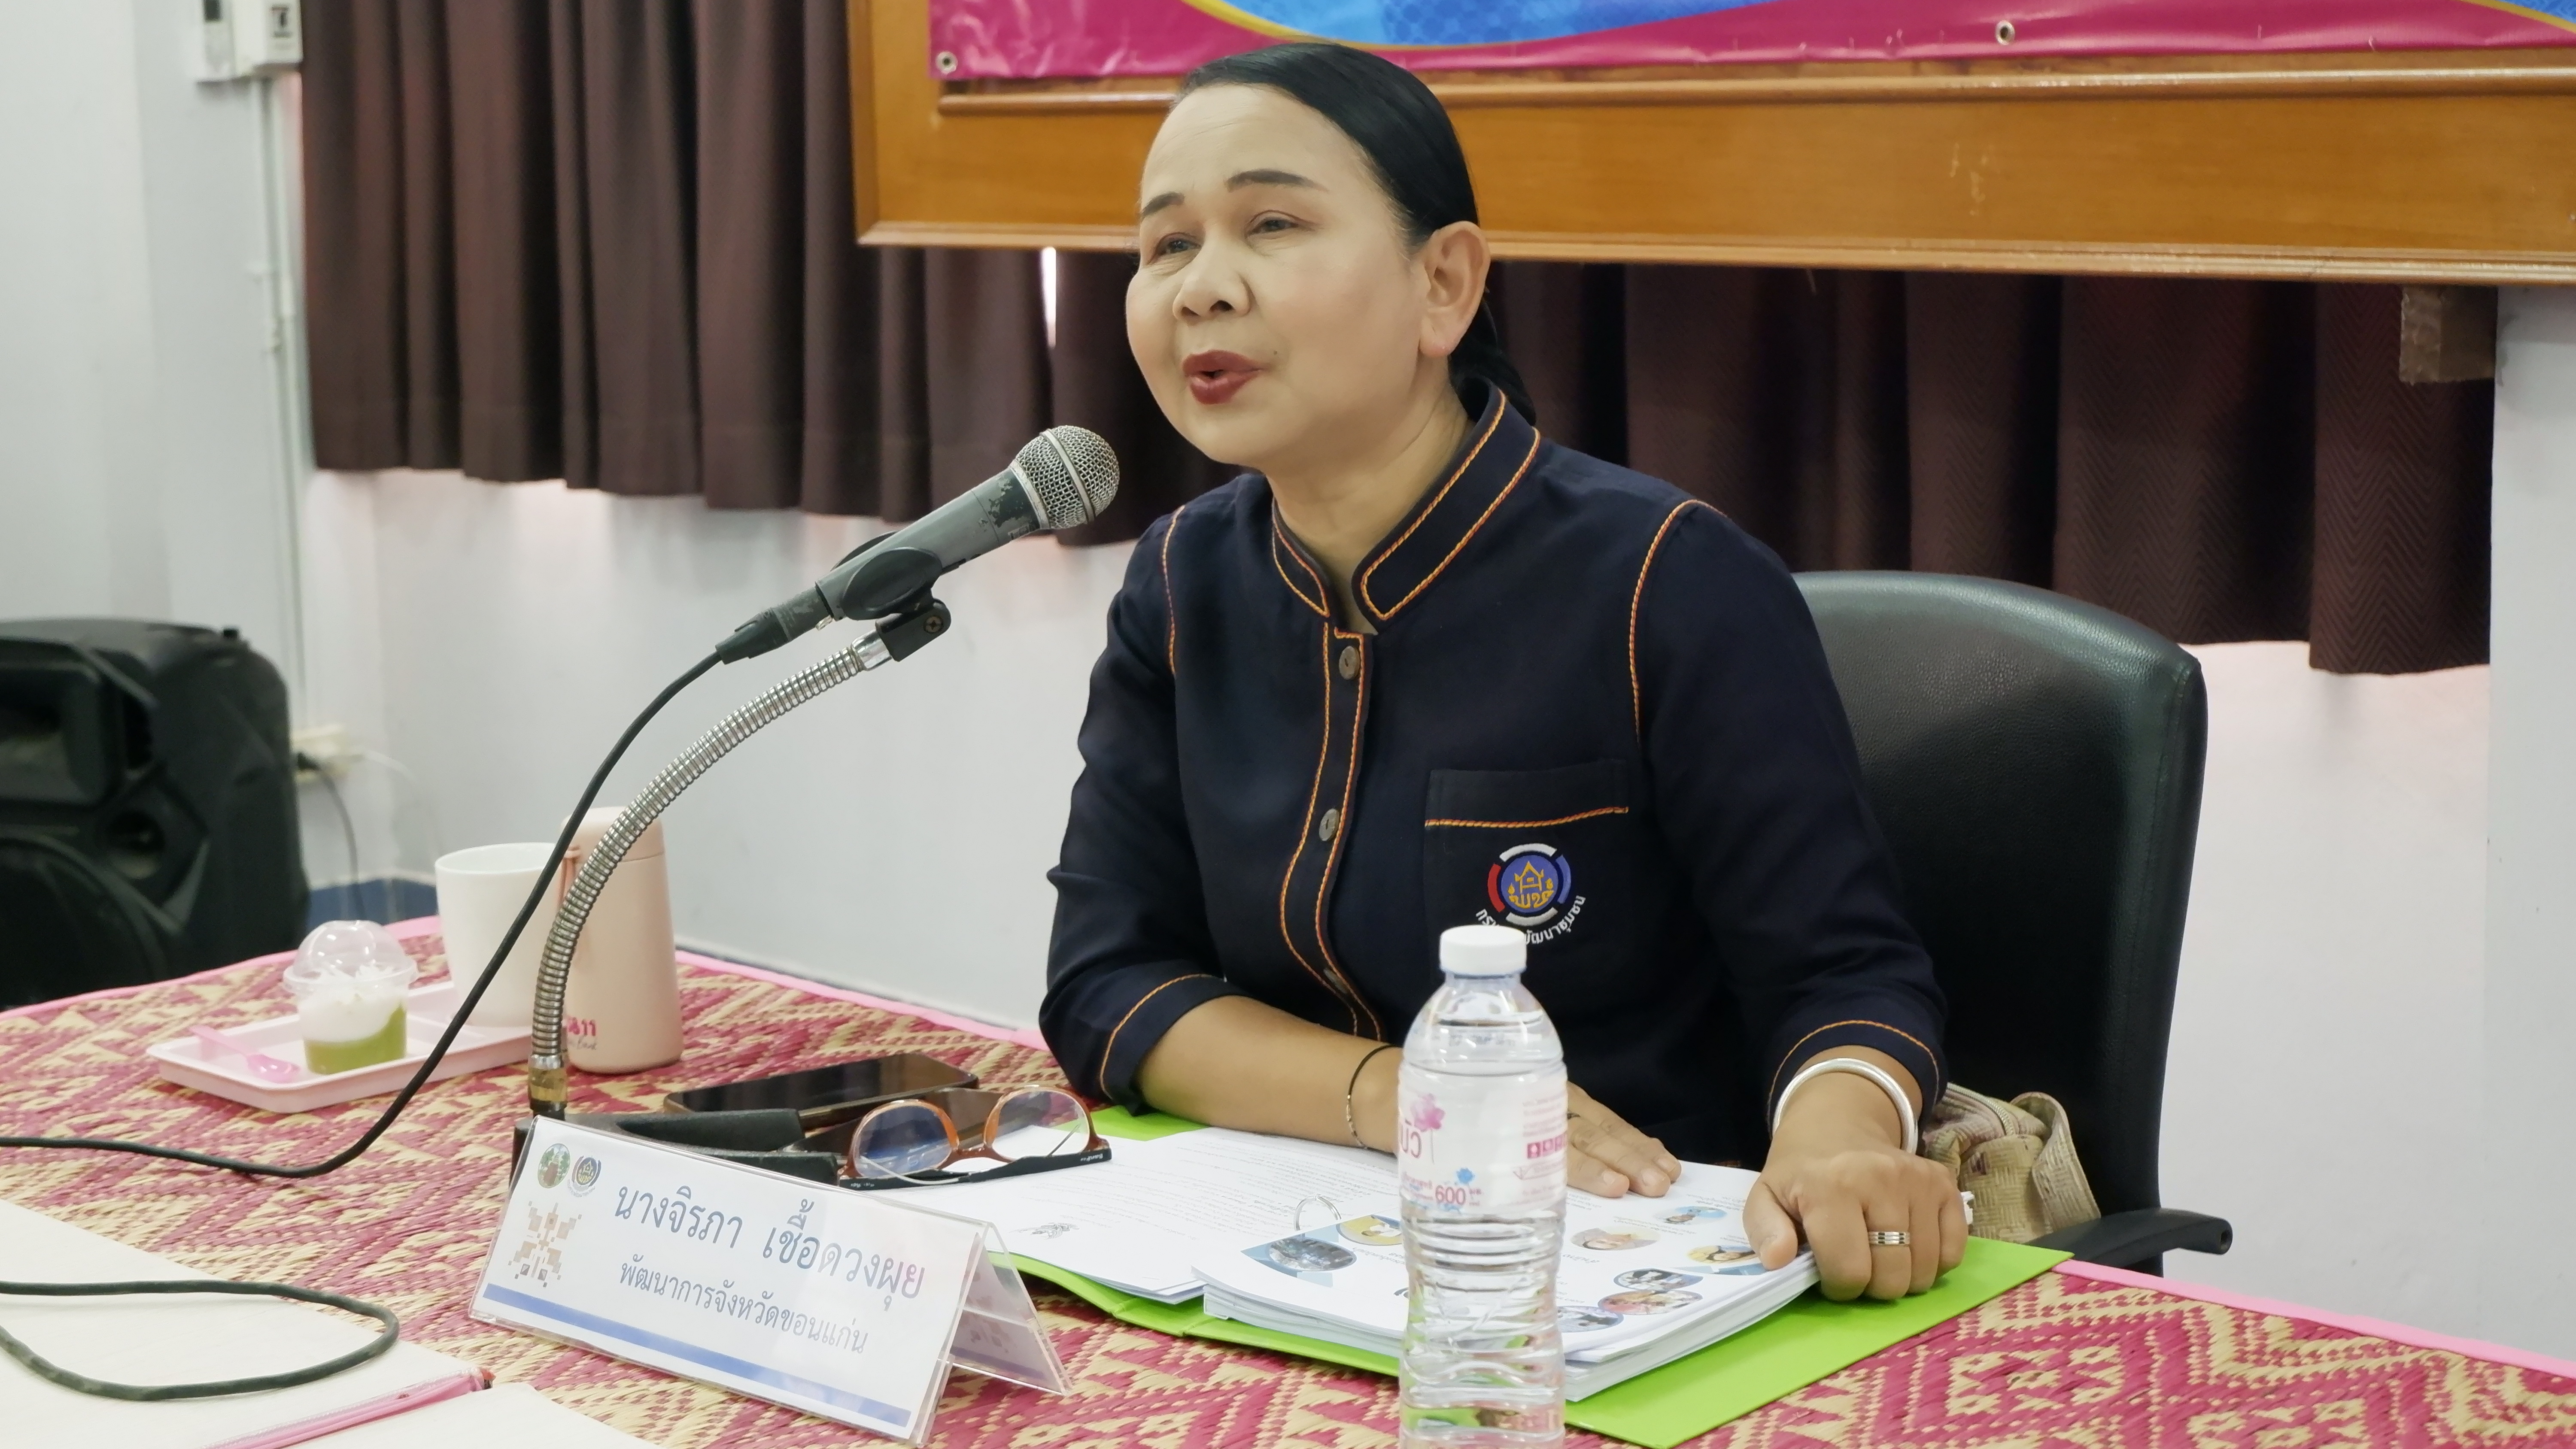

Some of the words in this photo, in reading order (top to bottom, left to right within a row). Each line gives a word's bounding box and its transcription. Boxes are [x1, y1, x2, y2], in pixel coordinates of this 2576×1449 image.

[1435, 1185, 1466, 1206] 600
[615, 1185, 743, 1249] นางจิรภา
[762, 1198, 925, 1312] เชื้อดวงผุย
[619, 1253, 869, 1354] พัฒนาการจังหวัดขอนแก่น
